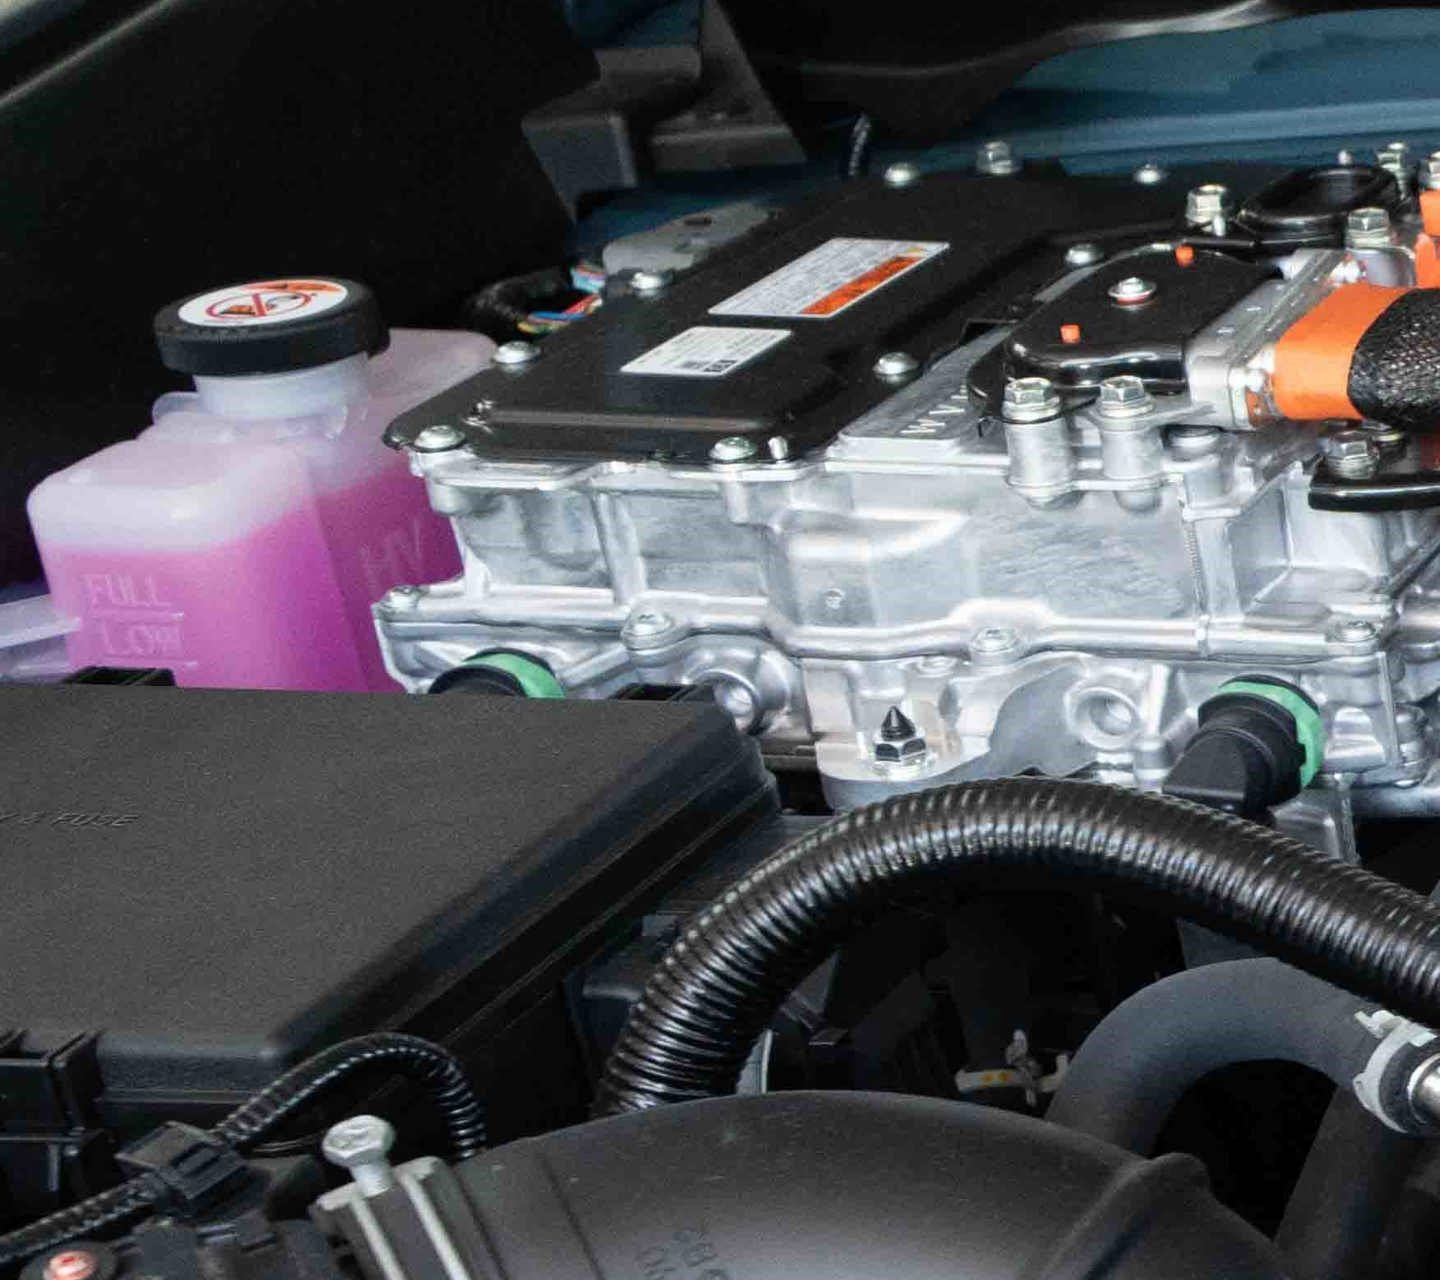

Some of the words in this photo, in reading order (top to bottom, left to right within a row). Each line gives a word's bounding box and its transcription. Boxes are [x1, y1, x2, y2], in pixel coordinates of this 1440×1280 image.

[79, 571, 173, 607] FULL
[101, 620, 185, 656] LOW
[51, 812, 140, 827] FUSE
